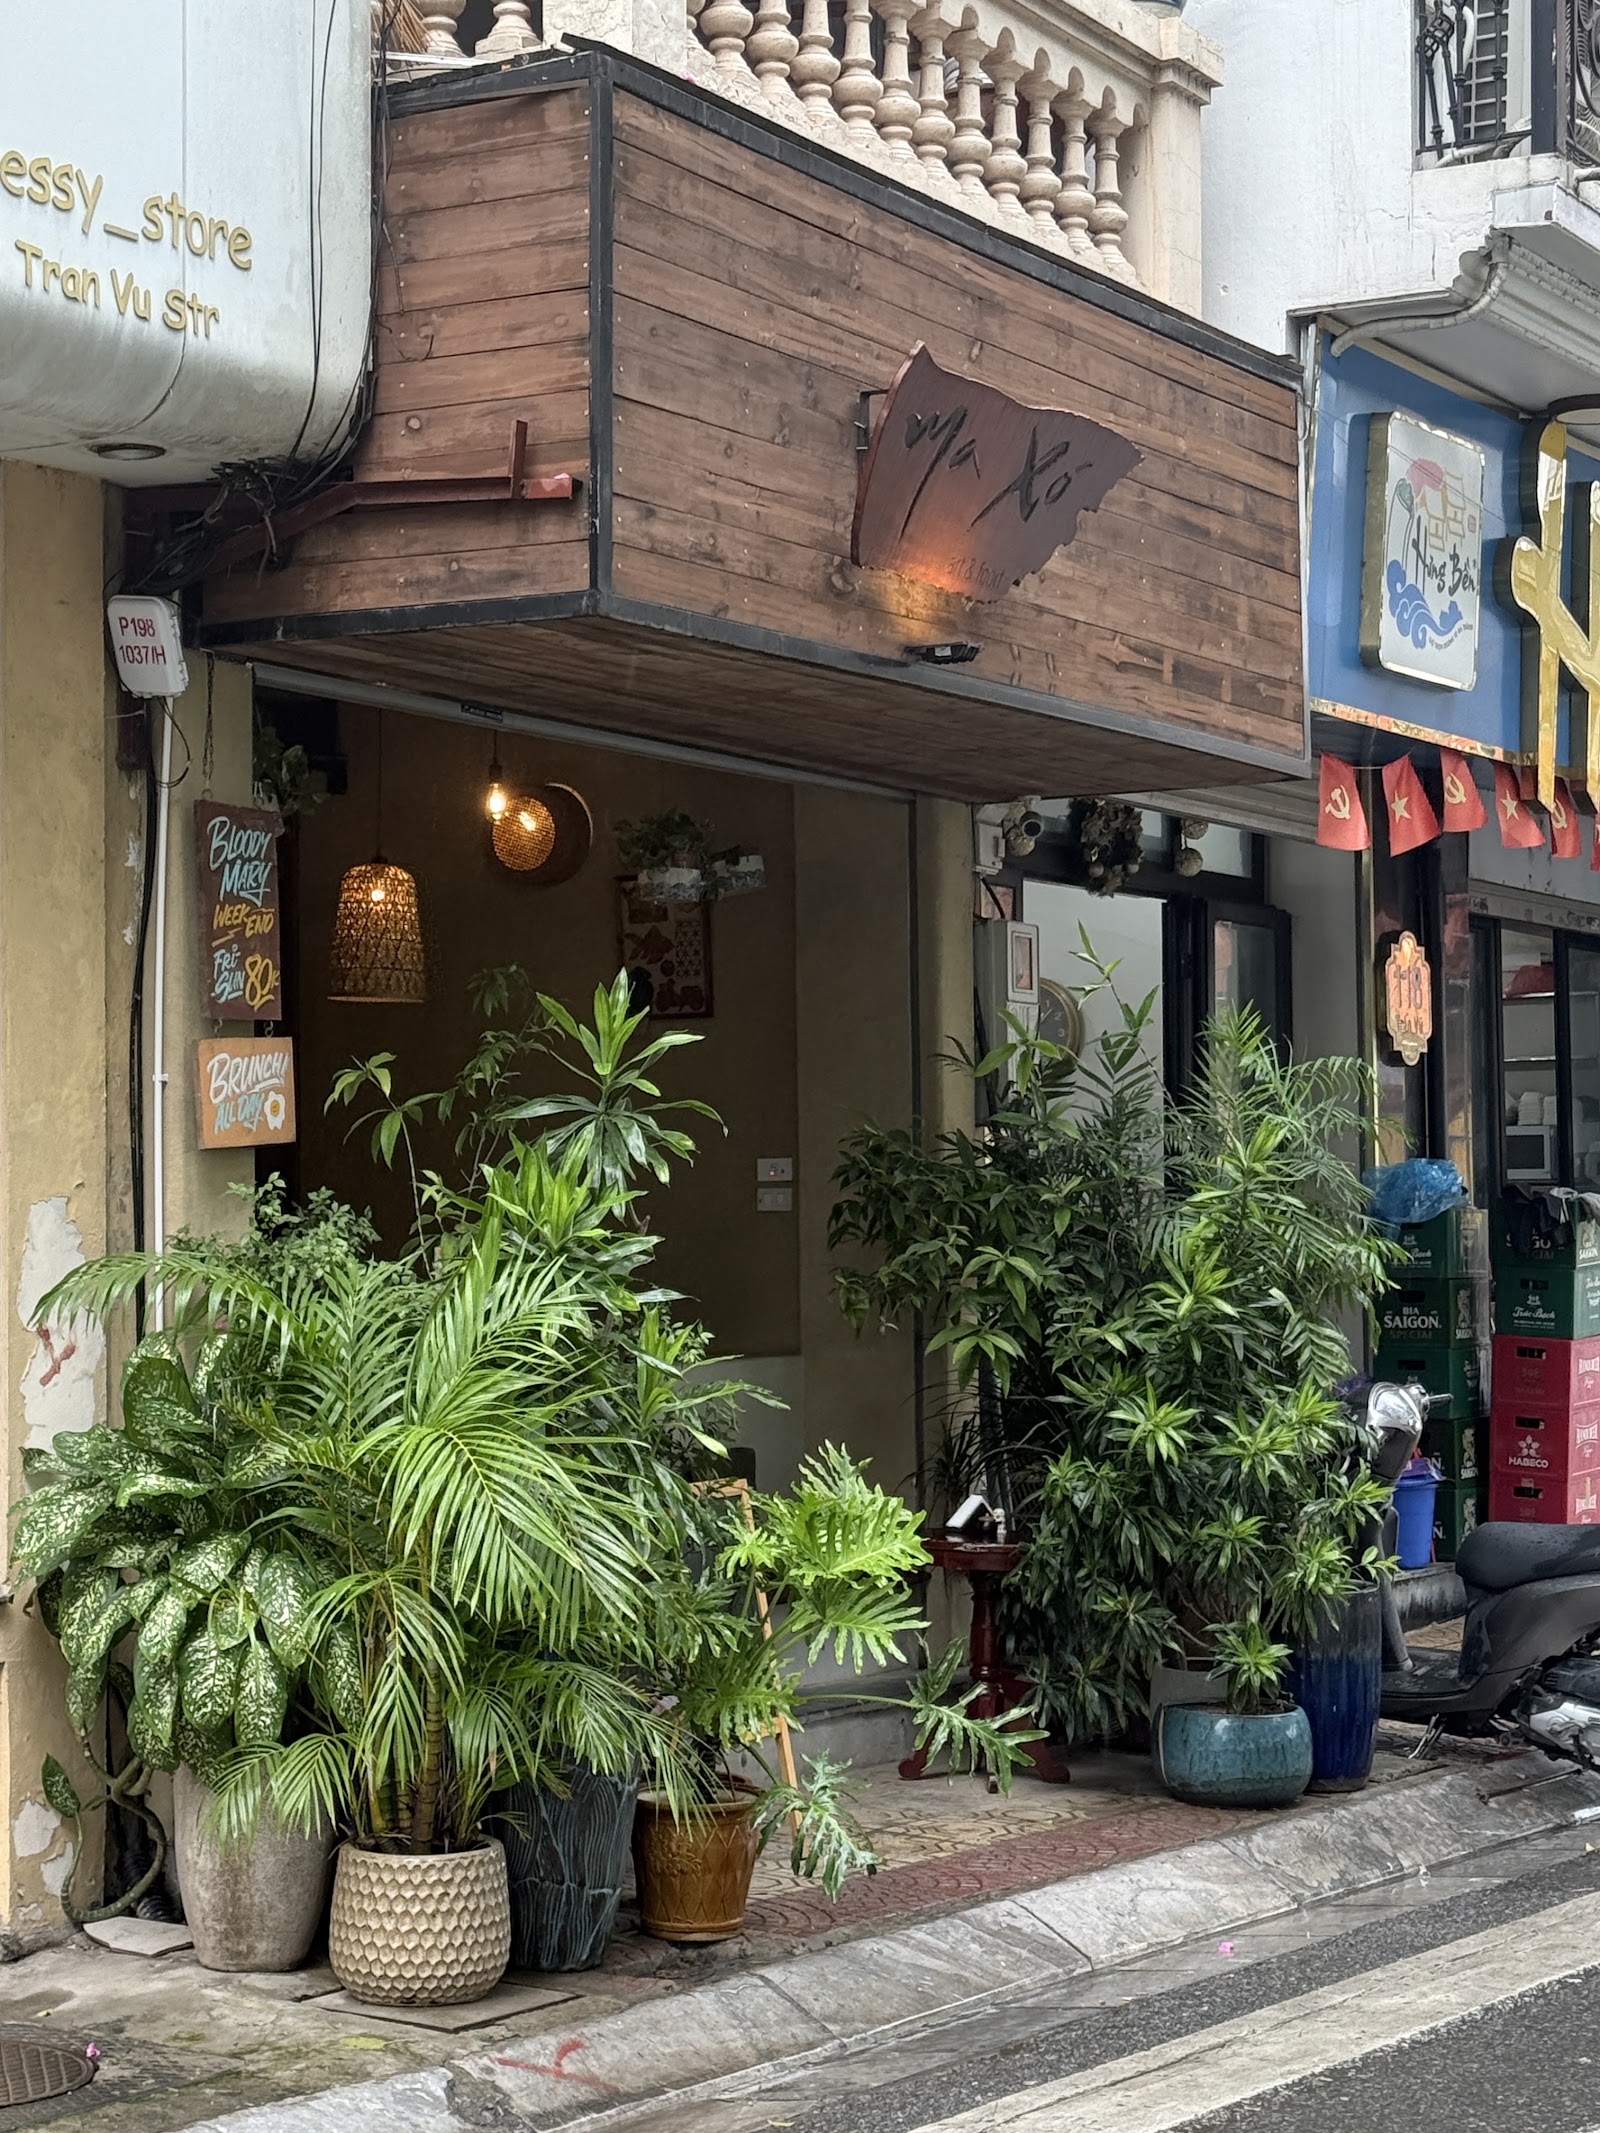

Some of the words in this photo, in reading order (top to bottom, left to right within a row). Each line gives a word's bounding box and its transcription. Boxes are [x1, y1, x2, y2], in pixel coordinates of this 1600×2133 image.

[15, 240, 101, 308] Tran
[110, 269, 151, 323] Vu
[162, 289, 220, 338] Str
[119, 616, 156, 637] P198
[206, 816, 272, 871] BLOODY
[220, 859, 273, 908] MARY
[211, 970, 245, 1004] SUN
[1383, 1315, 1440, 1330] SAIGON
[1402, 1306, 1420, 1316] BIA
[1508, 1456, 1549, 1469] HABECO
